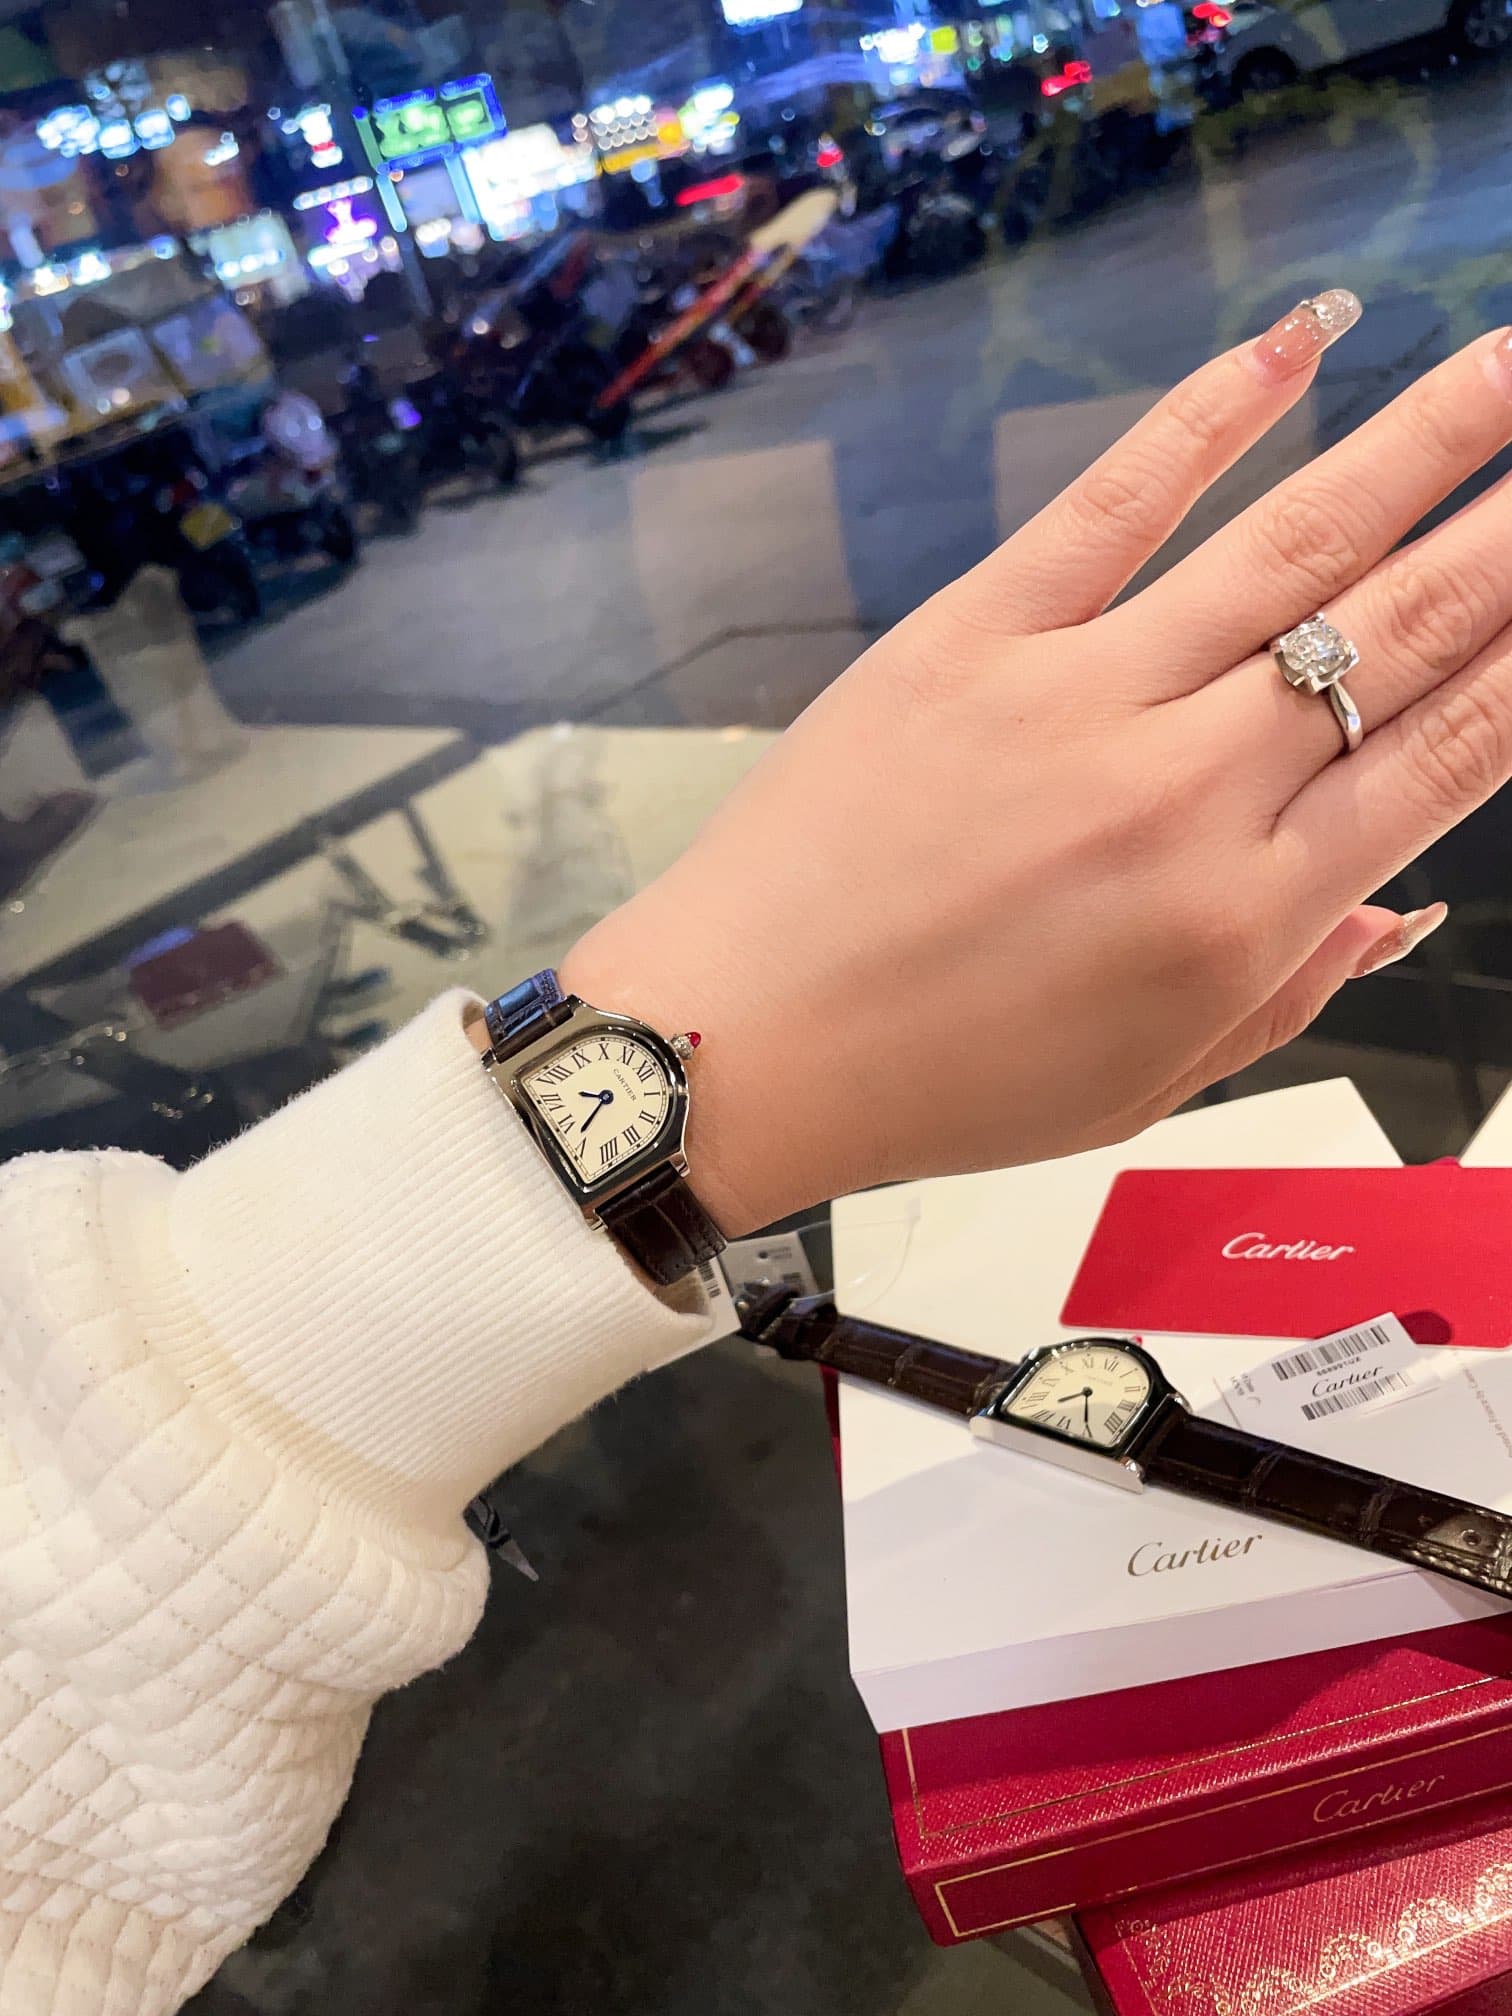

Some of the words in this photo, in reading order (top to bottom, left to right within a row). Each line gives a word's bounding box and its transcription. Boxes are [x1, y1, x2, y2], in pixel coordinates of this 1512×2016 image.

[571, 1048, 593, 1069] IX
[598, 1043, 610, 1061] X
[616, 1045, 636, 1066] XI
[536, 1065, 575, 1085] VIII
[632, 1060, 656, 1083] XII
[613, 1068, 638, 1102] CARTIER
[557, 1114, 576, 1134] VI
[638, 1110, 657, 1125] II
[622, 1124, 642, 1146] III
[574, 1136, 588, 1158] V
[599, 1136, 619, 1165] IIII
[1221, 1231, 1355, 1261] Cartier
[1312, 1365, 1384, 1397] Cartier
[1127, 1534, 1263, 1577] Cartier
[1313, 1774, 1445, 1823] Cartier
